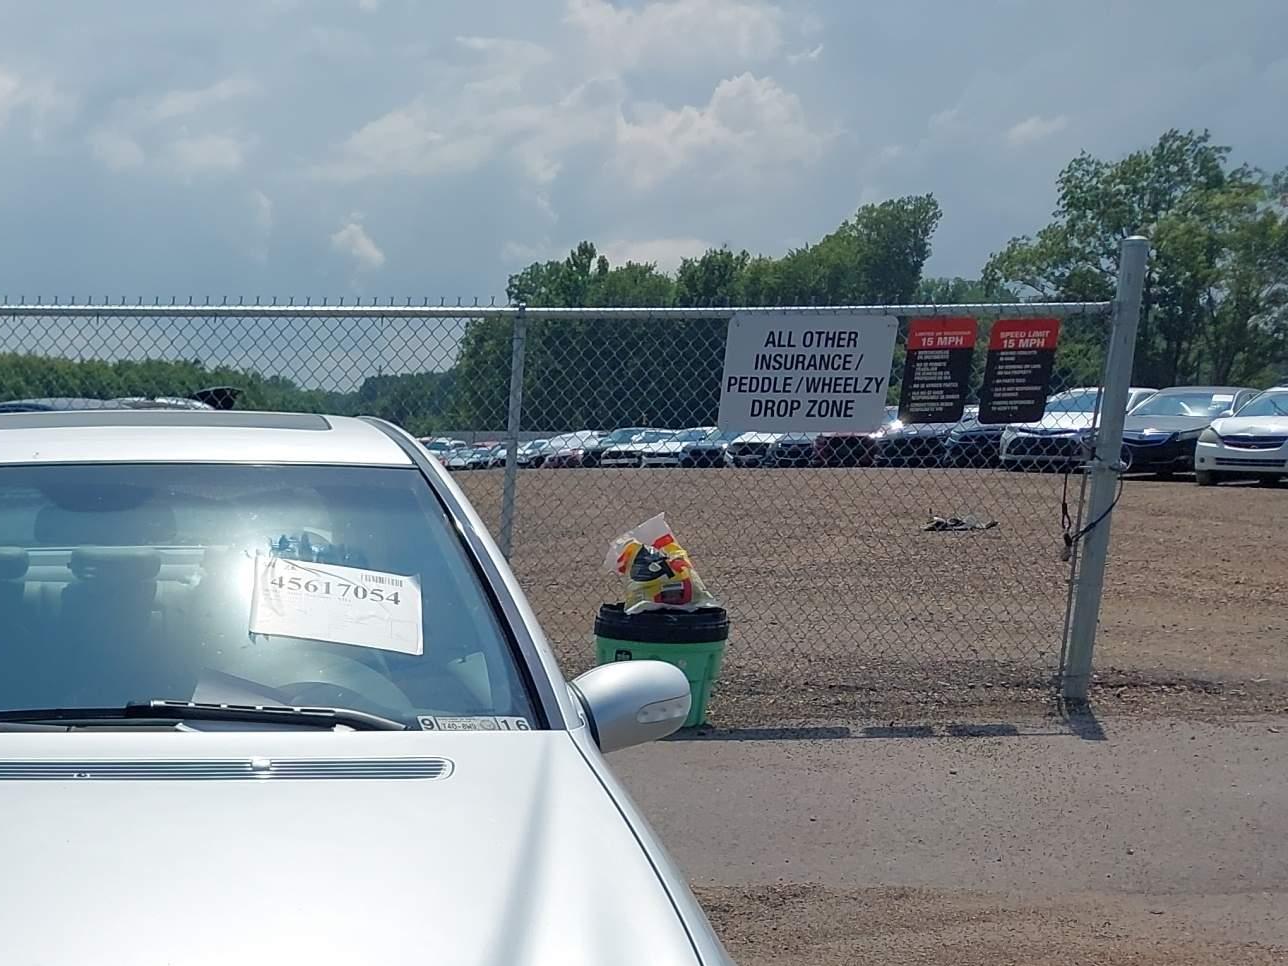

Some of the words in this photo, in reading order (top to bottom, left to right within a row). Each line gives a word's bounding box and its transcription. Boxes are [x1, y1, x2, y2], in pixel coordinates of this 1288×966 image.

[764, 331, 796, 348] ALL
[802, 331, 858, 348] OTHER
[921, 337, 934, 347] 15
[936, 336, 964, 347] MPH
[1002, 339, 1015, 349] 15
[1018, 338, 1045, 349] MPH
[754, 354, 853, 371] INSURANCE
[727, 376, 793, 394] PEDDLE
[750, 400, 801, 418] DROP
[806, 400, 855, 418] ZONE
[270, 575, 401, 606] 45617054
[420, 718, 435, 730] 9
